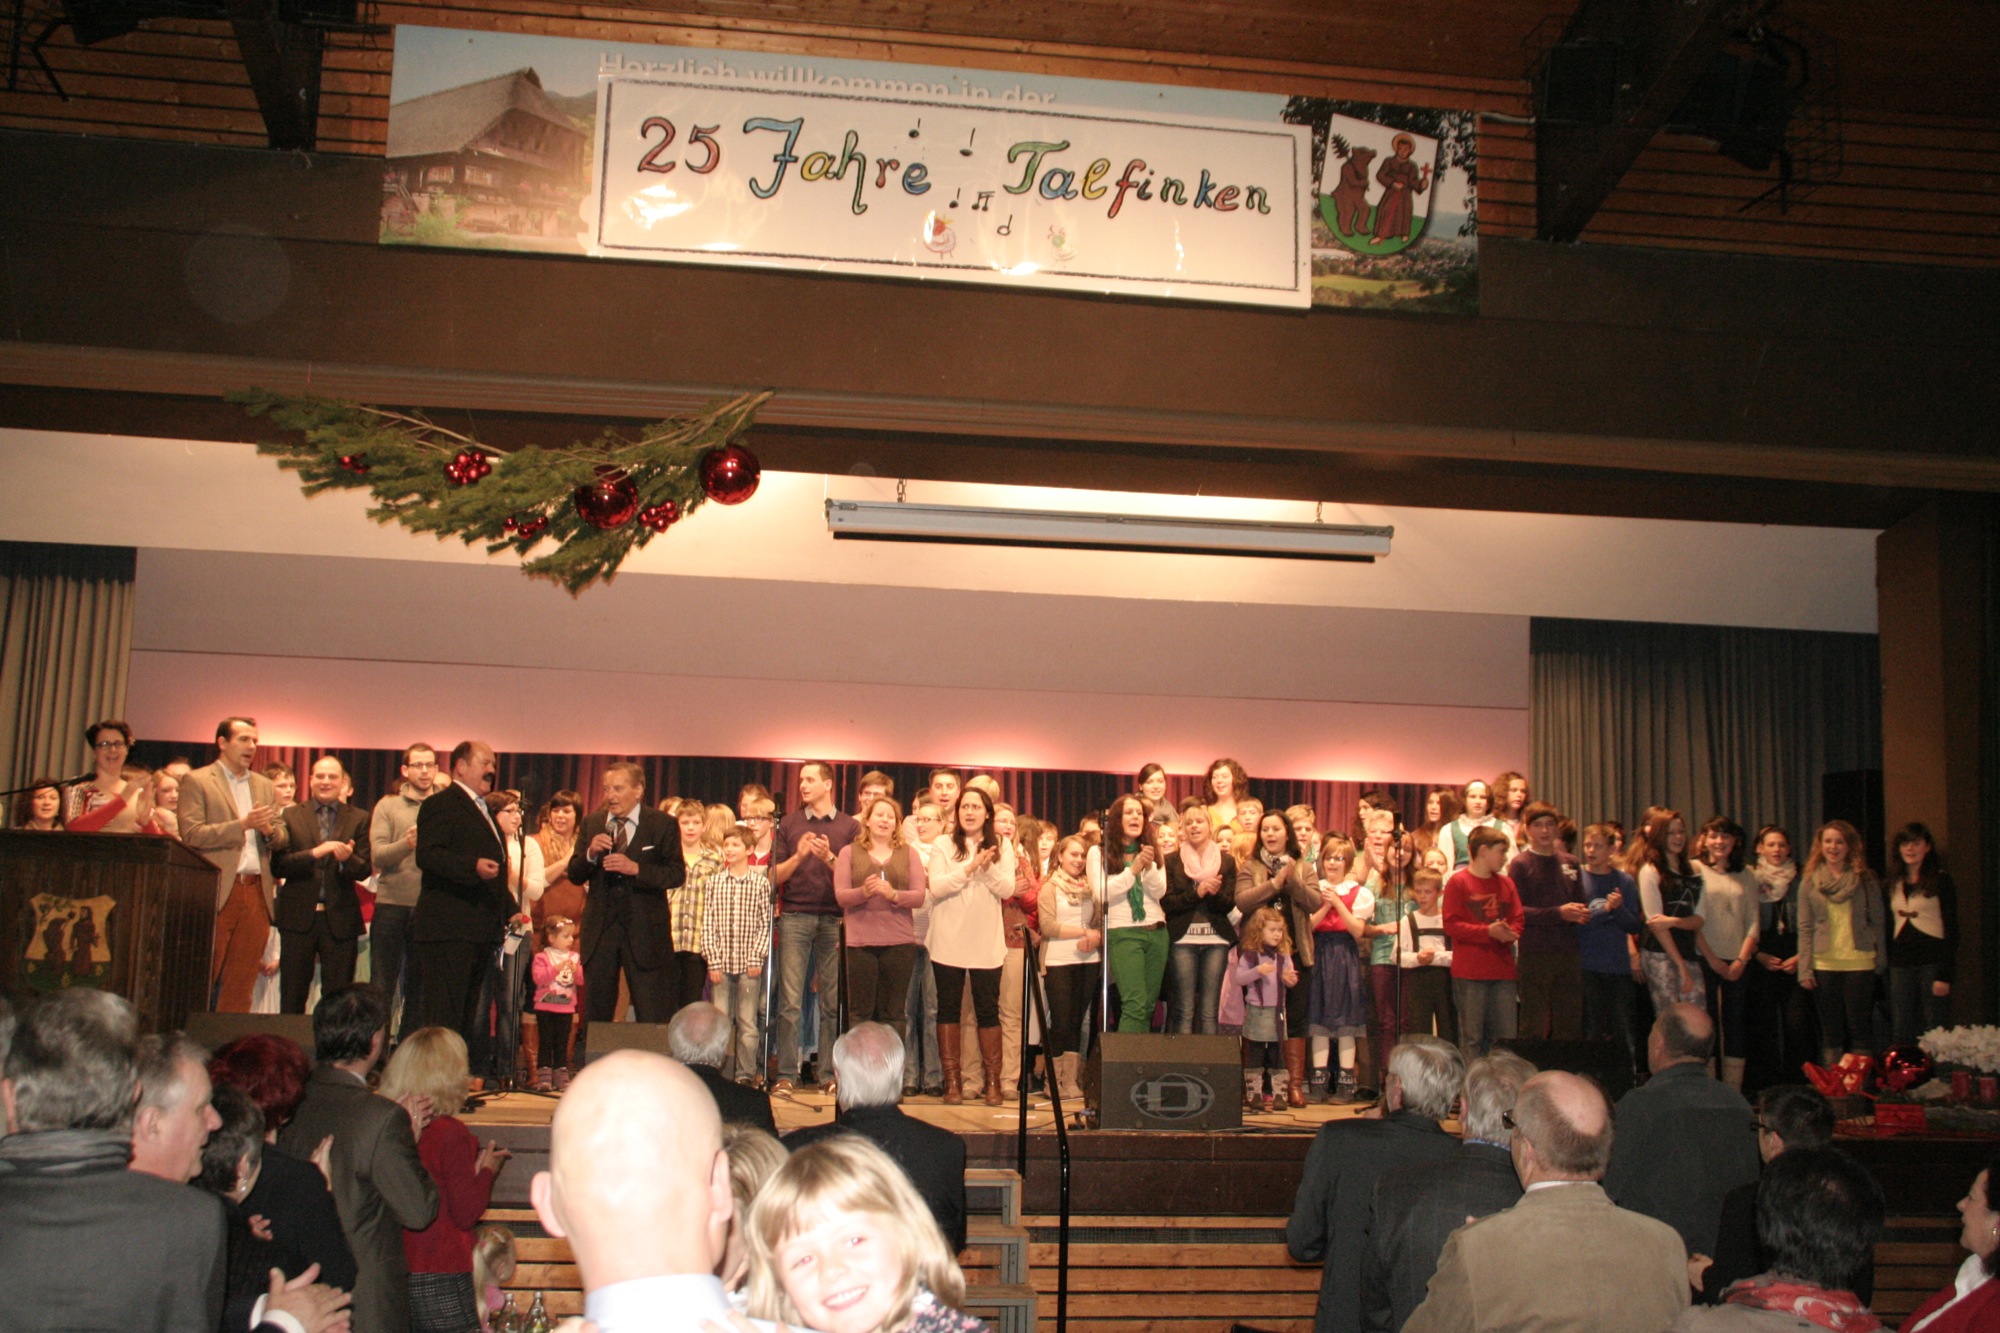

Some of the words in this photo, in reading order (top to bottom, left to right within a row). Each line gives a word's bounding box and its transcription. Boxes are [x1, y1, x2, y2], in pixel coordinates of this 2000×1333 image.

[637, 115, 721, 175] 25
[742, 117, 932, 216] Jahre
[1001, 139, 1272, 219] Talfinken
